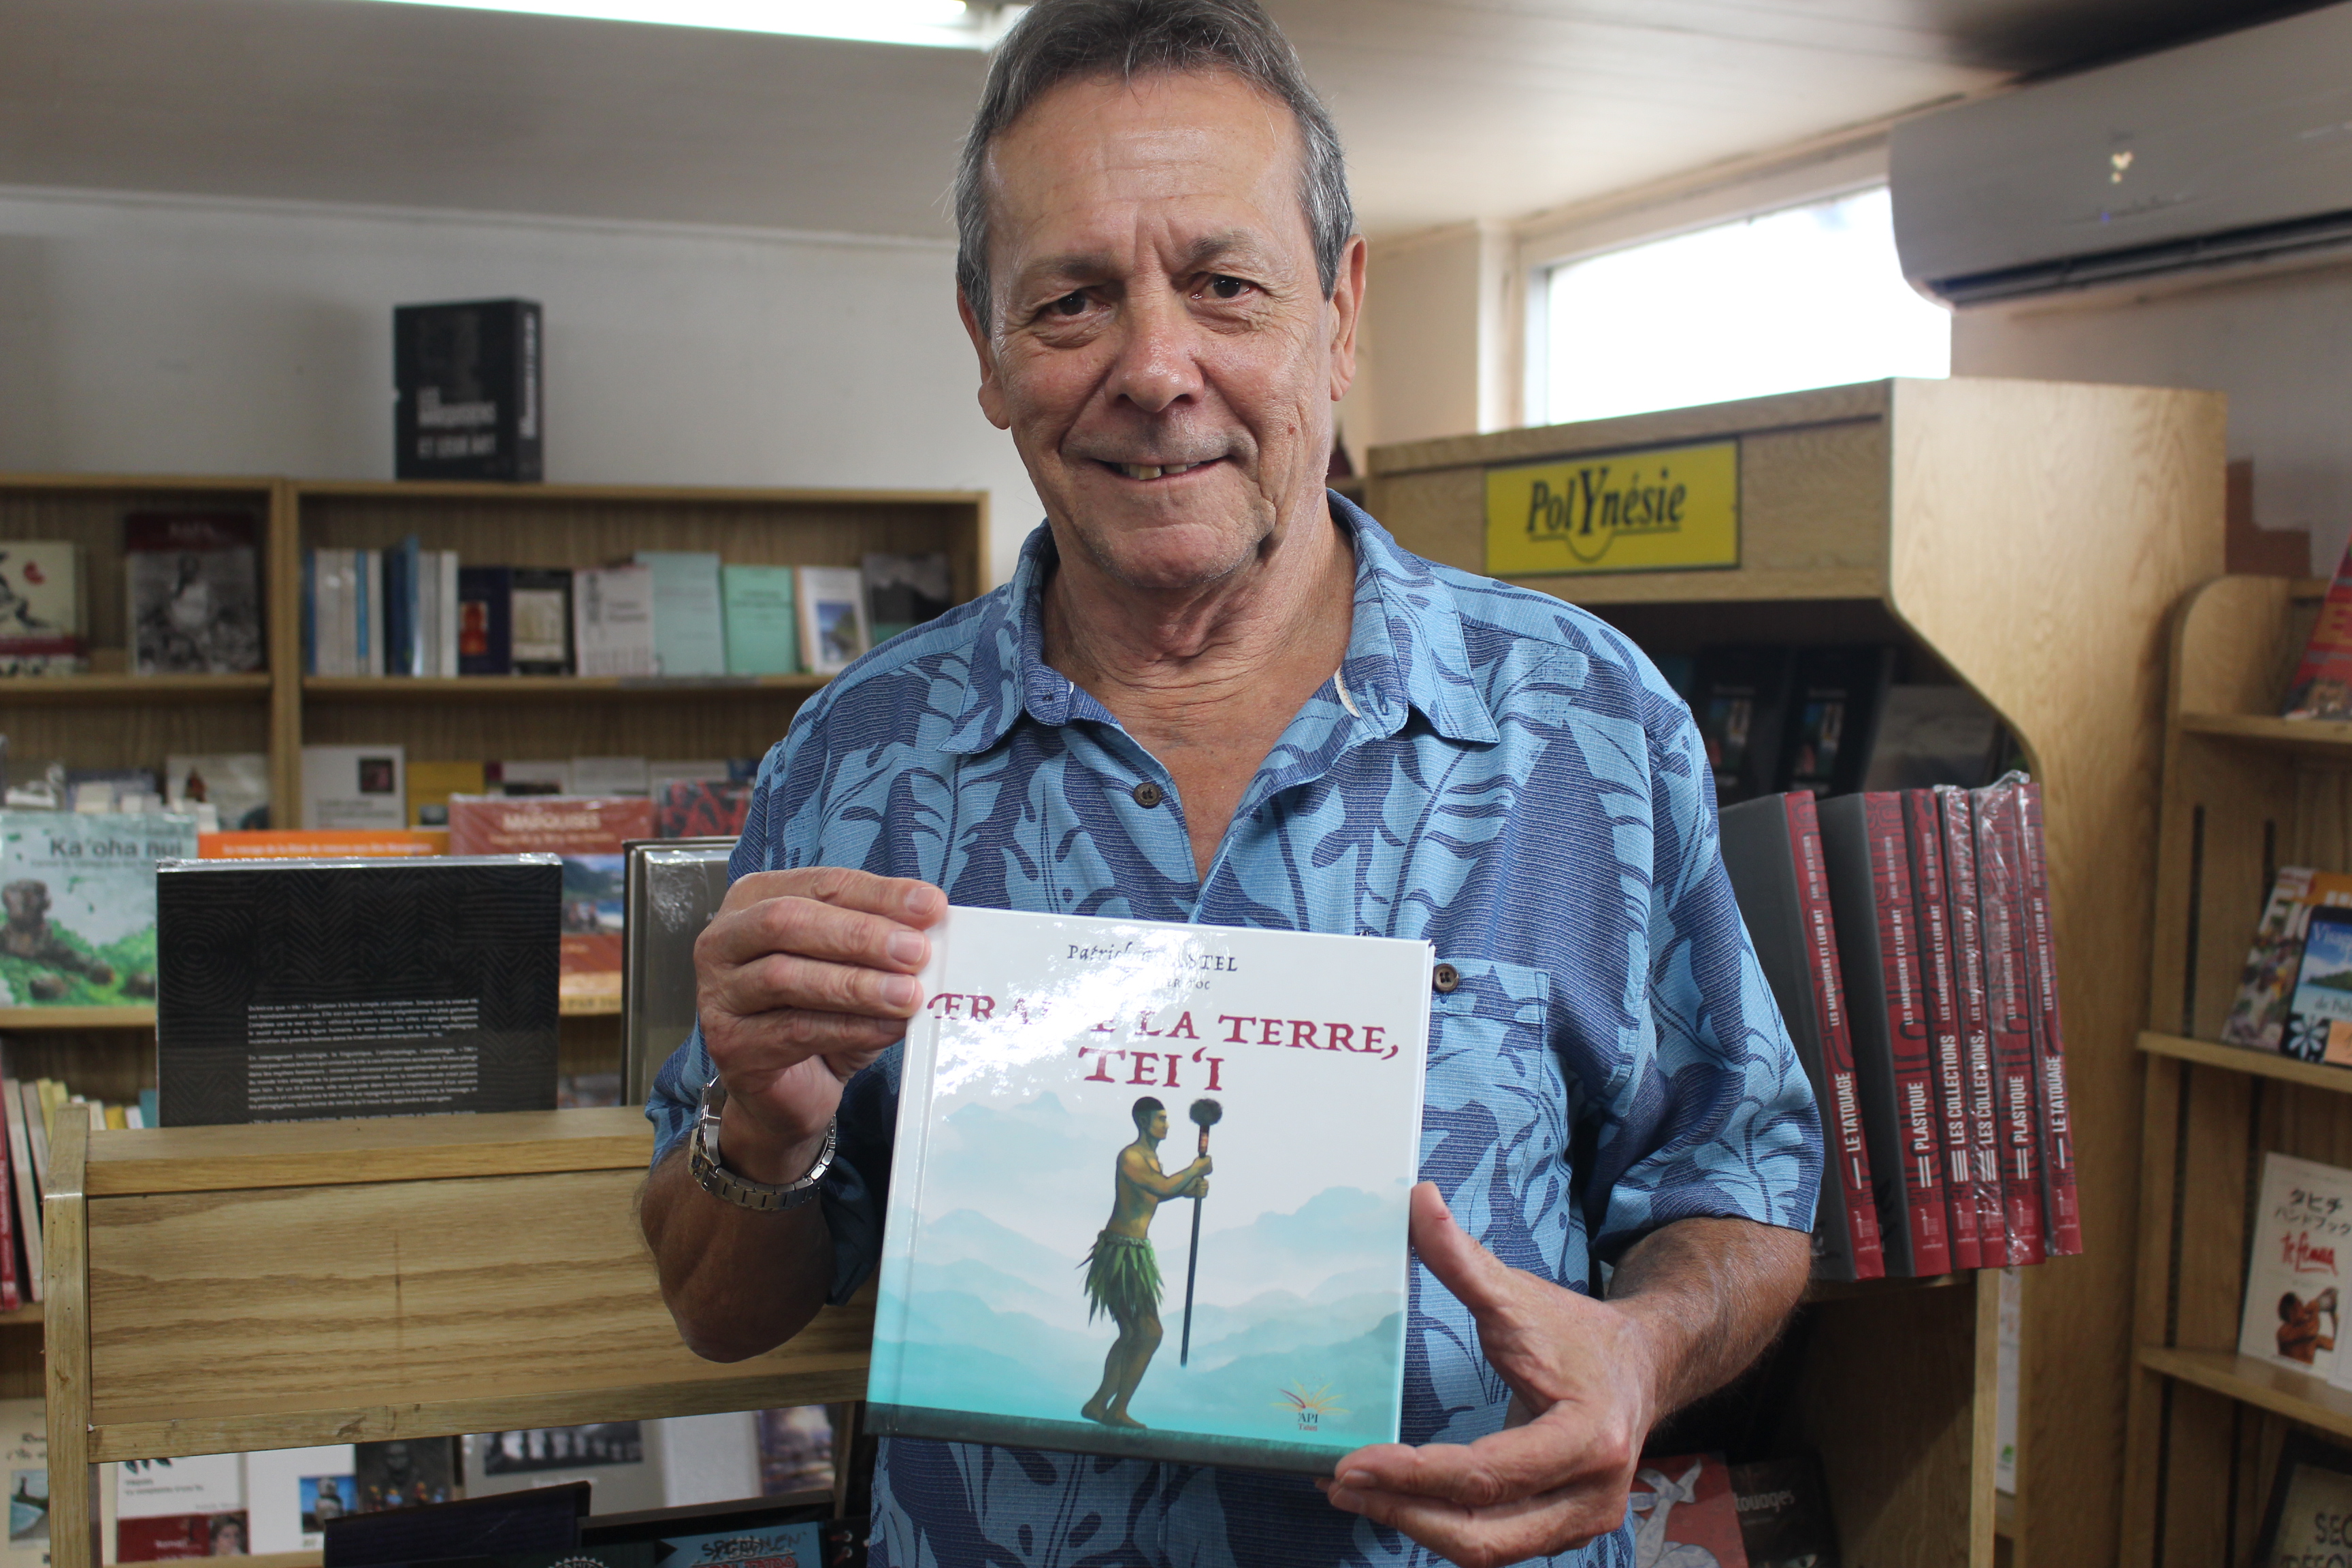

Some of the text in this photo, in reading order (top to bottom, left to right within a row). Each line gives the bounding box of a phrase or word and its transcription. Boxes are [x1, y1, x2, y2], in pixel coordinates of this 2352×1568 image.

[1526, 467, 1687, 536] PolYnésie
[1929, 904, 1940, 919] ART
[2034, 898, 2043, 912] ART
[1813, 909, 1824, 924] ART
[1892, 909, 1902, 924] ART
[2036, 913, 2046, 932] LEUR
[1816, 924, 1828, 945] LEUR
[1893, 924, 1904, 945] LEUR
[1931, 921, 1943, 941] LEUR
[2037, 934, 2047, 943] ET
[1819, 947, 1829, 956] ET
[1896, 947, 1906, 956] ET
[1934, 942, 1944, 952] ET
[2044, 996, 2053, 1011] LES
[1829, 1012, 1840, 1026] LES
[1904, 1011, 1914, 1026] LES
[1940, 1005, 1950, 1021] LES
[1134, 1011, 1200, 1039] LA
[1218, 1014, 1399, 1060] TERRE,
[1940, 1034, 1963, 1119] COLLECTIONS
[1970, 1034, 1991, 1120] COLLECTIONS
[2046, 1055, 2065, 1115] TATOUAGE
[1834, 1072, 1859, 1134] TATOUAGE
[2008, 1075, 2029, 1143] PLASTIQUE
[1908, 1081, 1930, 1150] PLASTIQUE
[2051, 1116, 2067, 1133] LE
[1949, 1122, 1965, 1145] LES
[1978, 1122, 1994, 1145] LES
[1844, 1135, 1861, 1153] LE
